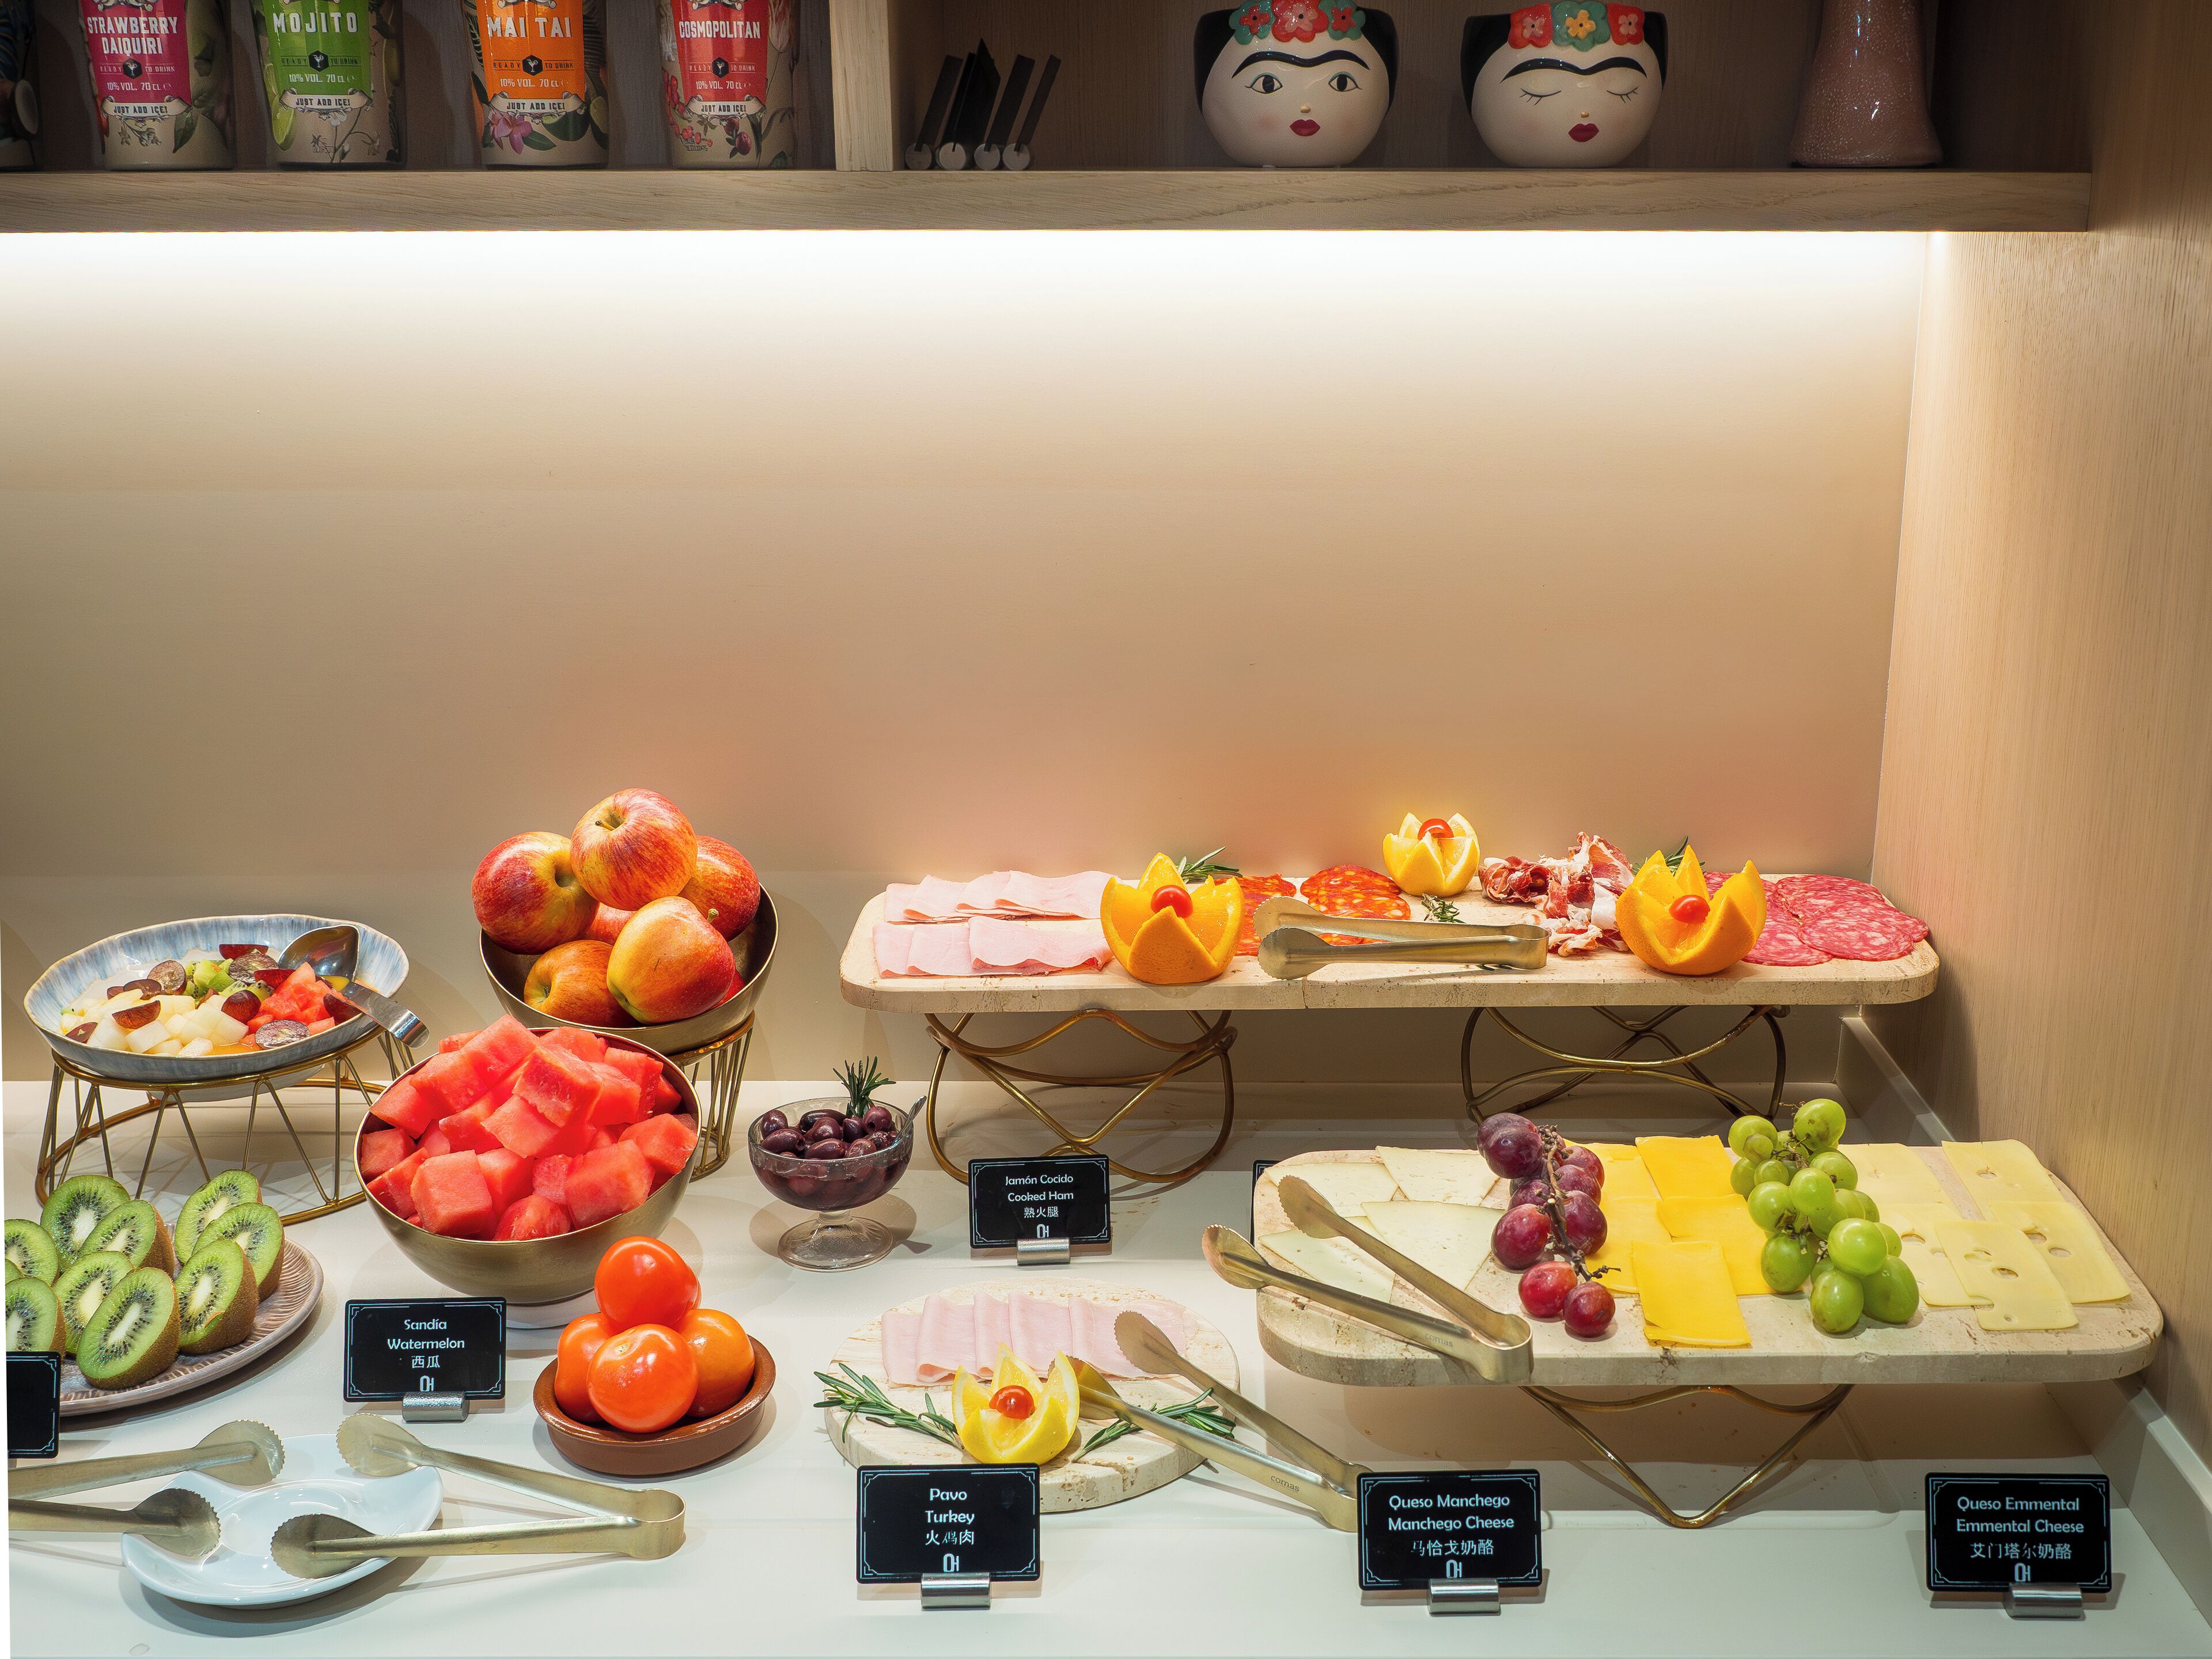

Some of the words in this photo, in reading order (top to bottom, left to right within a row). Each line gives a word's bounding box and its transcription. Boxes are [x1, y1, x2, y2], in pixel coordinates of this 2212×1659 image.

[87, 17, 178, 34] STRAWBERRY
[273, 12, 358, 33] MOJITO
[487, 17, 527, 37] MAI
[535, 17, 572, 37] TAI
[679, 21, 761, 39] COSMOPOLITAN
[101, 37, 163, 56] DAIQUIRI
[289, 74, 304, 82] 10%
[326, 74, 336, 83] 70
[500, 78, 516, 87] 10%
[539, 78, 549, 88] 70
[696, 81, 708, 89] 10%
[726, 81, 734, 89] 70
[107, 82, 120, 91] 10%
[120, 82, 138, 91] VOL.
[141, 82, 151, 91] 70
[296, 98, 313, 106] JUST
[335, 99, 351, 107] ICE!
[506, 102, 526, 110] JUST
[701, 104, 715, 112] JUST
[1005, 1176, 1037, 1185] Jamón
[1040, 1175, 1073, 1183] Cocido
[1008, 1192, 1046, 1202] Cooked
[1049, 1191, 1073, 1200] Ham
[1024, 1207, 1059, 1218] 熟火腿
[404, 1319, 447, 1330] Sandía
[387, 1338, 464, 1350] Watermelon
[411, 1355, 440, 1369] 西瓜
[1271, 1475, 1300, 1492] comas
[930, 1488, 967, 1501] Pavo
[1389, 1495, 1433, 1510] Queso
[1437, 1494, 1510, 1508] Manchego
[1957, 1497, 2001, 1512] Queso
[2006, 1497, 2079, 1510] Emmental
[925, 1510, 975, 1525] Turkey
[1388, 1517, 1461, 1531] Manchego
[1466, 1516, 1514, 1529] Cheese
[1957, 1519, 2030, 1532] Emmental
[2035, 1520, 2084, 1533] Cheese
[1411, 1539, 1494, 1556] 马恰戈奶酪
[1971, 1543, 2072, 1559] 艾门塔尔奶酪
